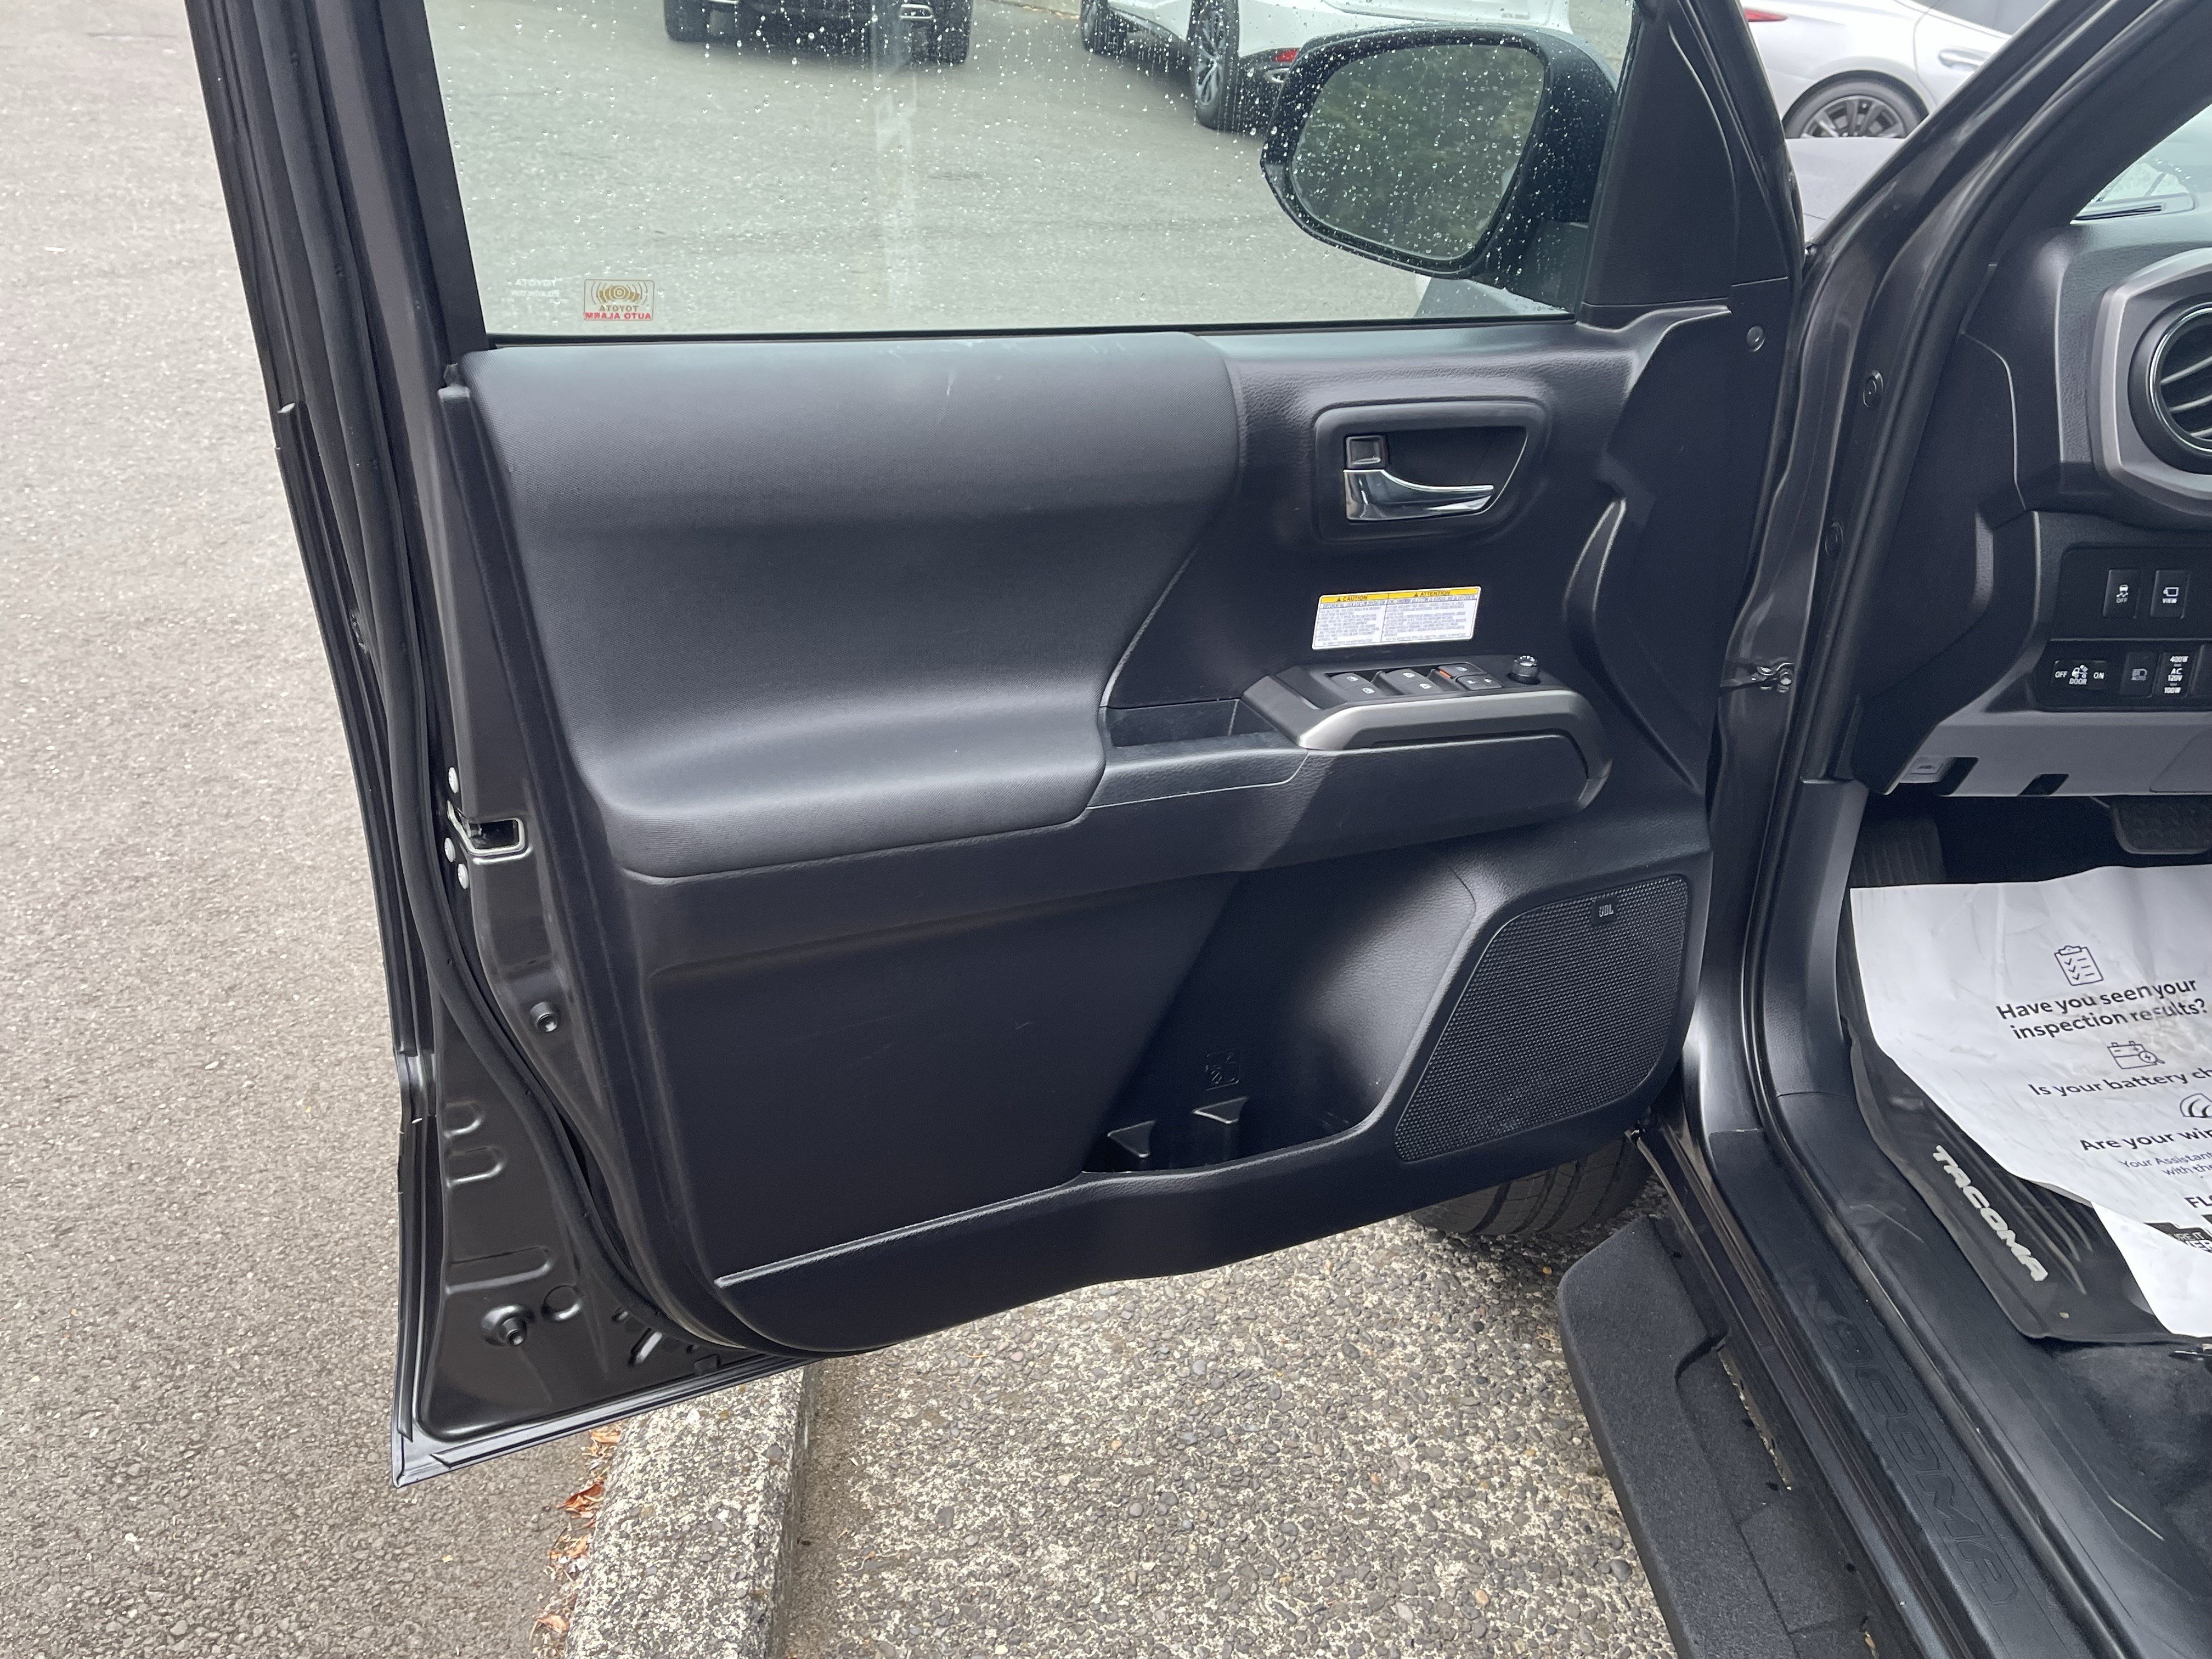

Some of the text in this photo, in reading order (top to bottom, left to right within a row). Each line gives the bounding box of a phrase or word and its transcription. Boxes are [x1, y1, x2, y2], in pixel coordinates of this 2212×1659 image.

[1599, 904, 1614, 917] JBL
[1995, 979, 2198, 1020] Have you seen your
[2011, 997, 2208, 1039] inspection results?
[2028, 1083, 2052, 1096] Is
[2053, 1083, 2102, 1097] your
[2102, 1073, 2189, 1091] battery
[2079, 1138, 2122, 1152] Are
[2121, 1133, 2175, 1150] your
[2119, 1152, 2212, 1169] Your Assistant
[2162, 1165, 2194, 1176] with
[1932, 1144, 2049, 1282] TACOMA
